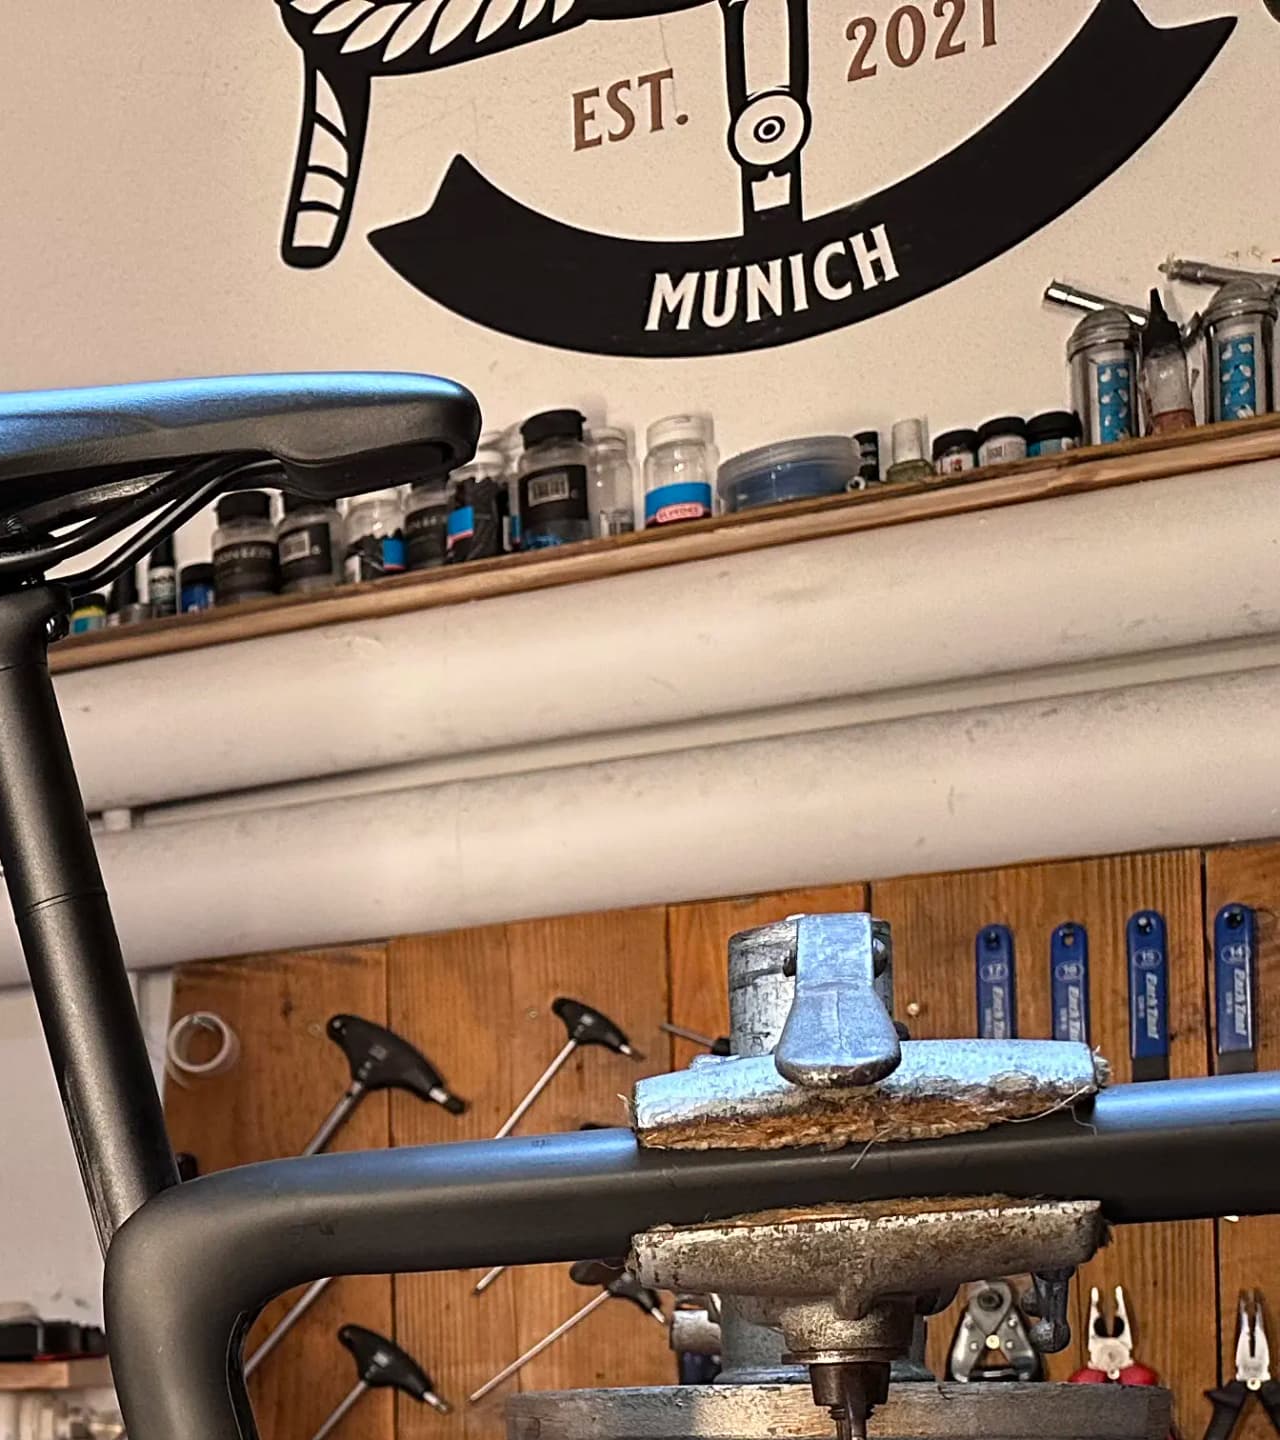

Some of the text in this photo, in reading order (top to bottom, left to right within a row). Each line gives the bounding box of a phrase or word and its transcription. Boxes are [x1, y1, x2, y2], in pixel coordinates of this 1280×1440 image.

[571, 0, 1000, 153] EST. 2021
[643, 223, 900, 331] MUNICH
